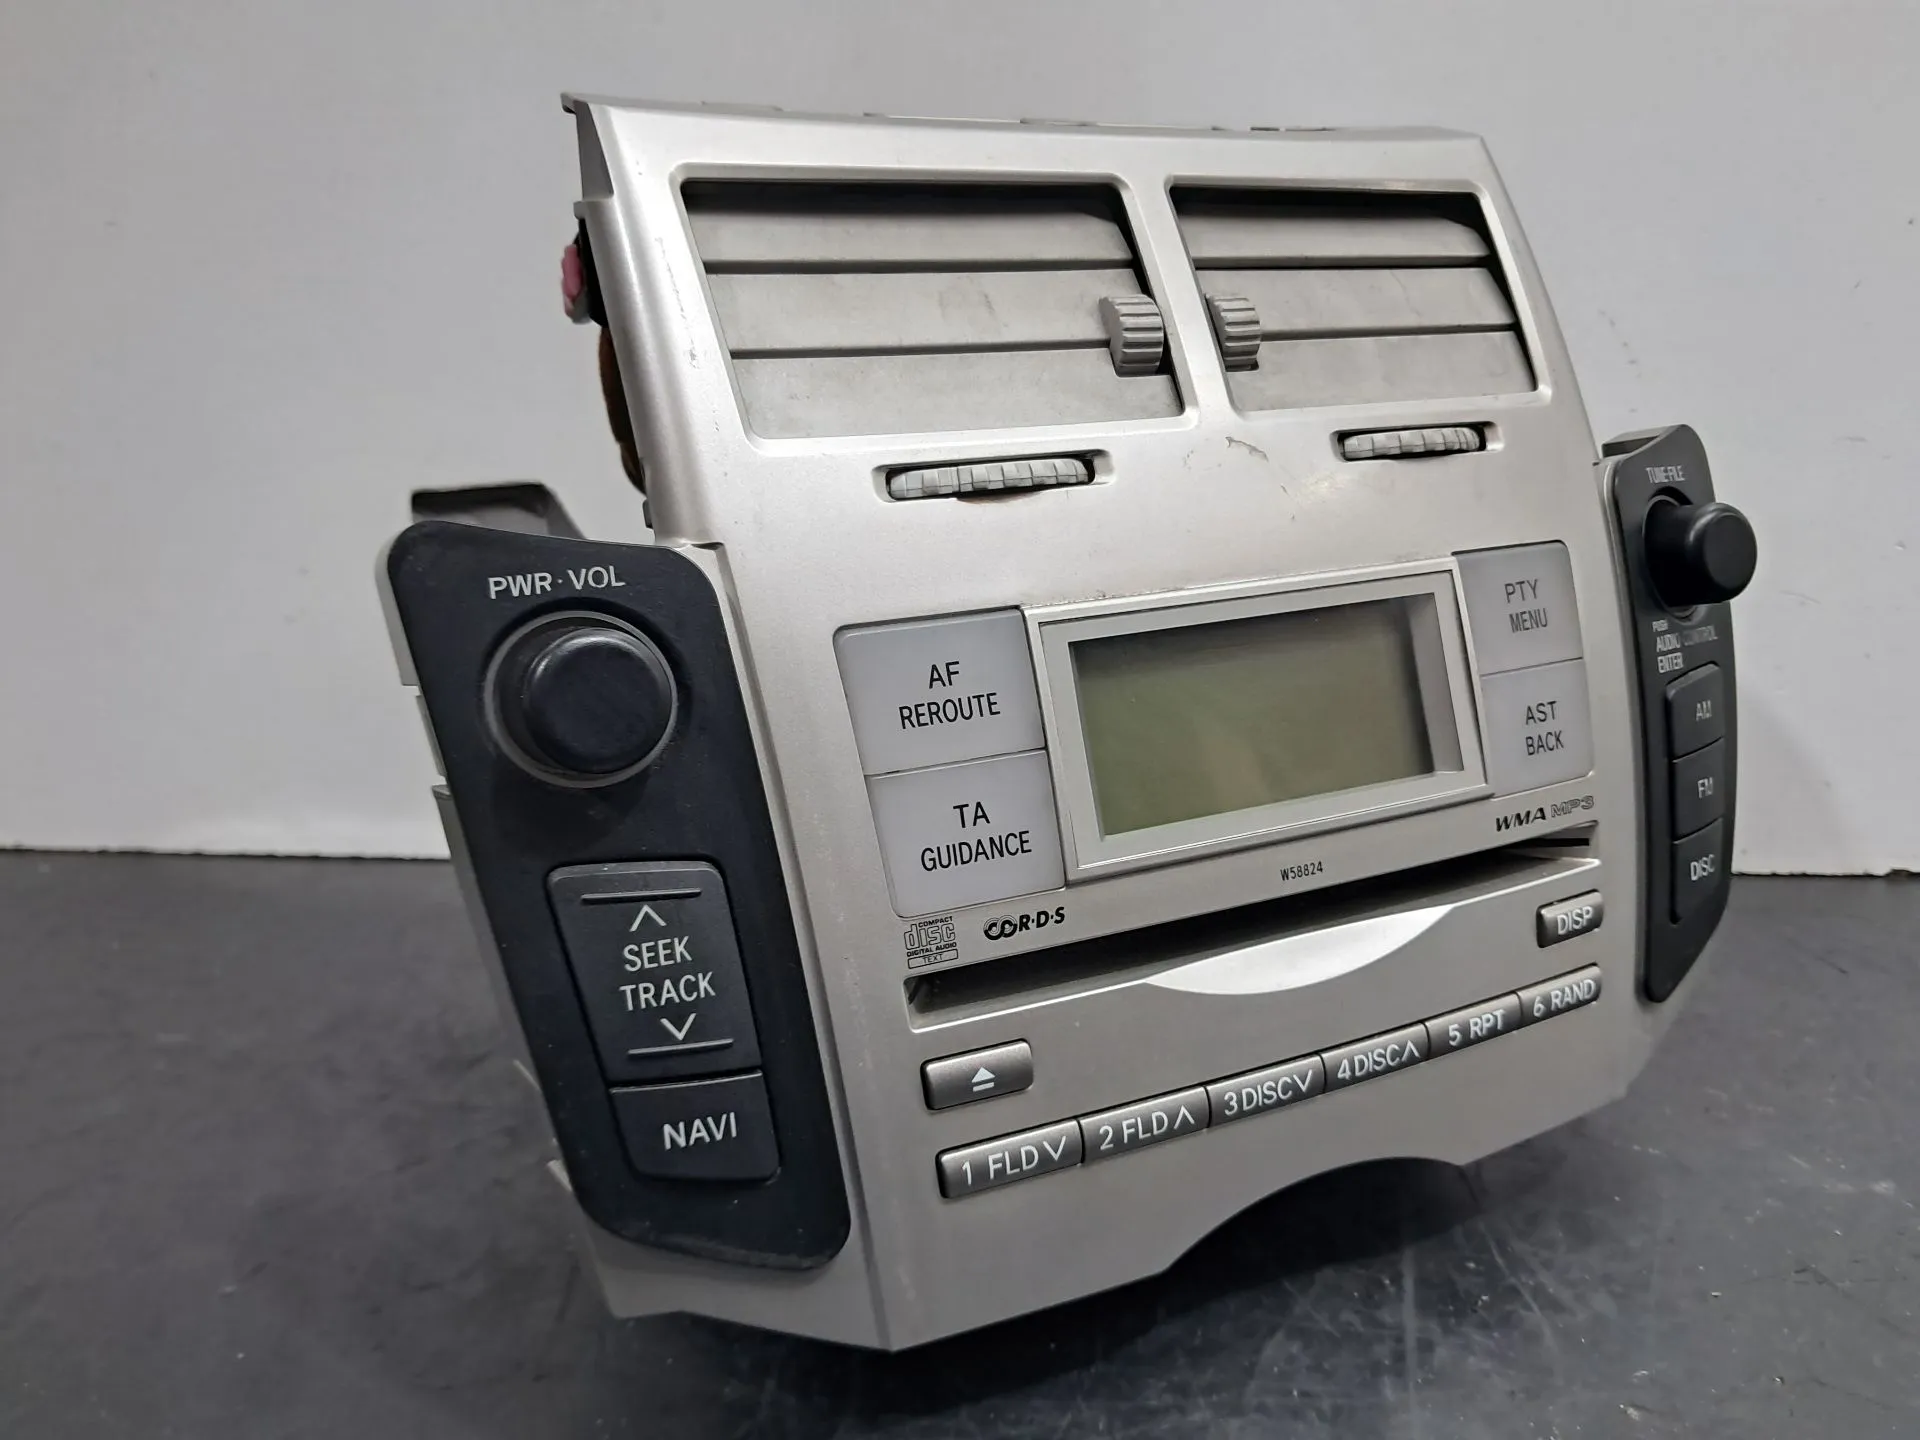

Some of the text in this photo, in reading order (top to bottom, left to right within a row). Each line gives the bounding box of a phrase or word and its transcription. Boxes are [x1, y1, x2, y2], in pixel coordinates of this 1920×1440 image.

[1504, 578, 1538, 603] PTY
[1509, 608, 1549, 633] MENU
[1656, 632, 1681, 652] AUDIO
[928, 661, 961, 689] AF
[1657, 652, 1684, 673] ENTER
[899, 692, 1001, 729] REROUTE
[1525, 701, 1557, 725] AST
[1696, 700, 1712, 721] AM
[1525, 730, 1564, 756] BACK
[1697, 777, 1713, 798] FM
[953, 801, 991, 829] TA
[1495, 795, 1595, 832] WMA MP3
[920, 830, 1032, 872] GUIDANCE
[1280, 861, 1324, 881] W58824
[1690, 854, 1715, 881] DISC
[918, 916, 953, 928] COMPACT
[1557, 905, 1592, 936] DISP
[904, 922, 956, 950] disc
[906, 942, 957, 957] DIGITAL AUDIO
[623, 936, 692, 972] SEEK
[922, 953, 943, 963] TEXT
[620, 971, 716, 1011] TRACK
[1532, 978, 1596, 1017] 6 RAND
[1449, 1008, 1505, 1046] 5 RPT
[663, 1112, 737, 1150] NAVI
[1100, 1110, 1169, 1150] 2 FLD
[962, 1144, 1039, 1186] 1 FLD
